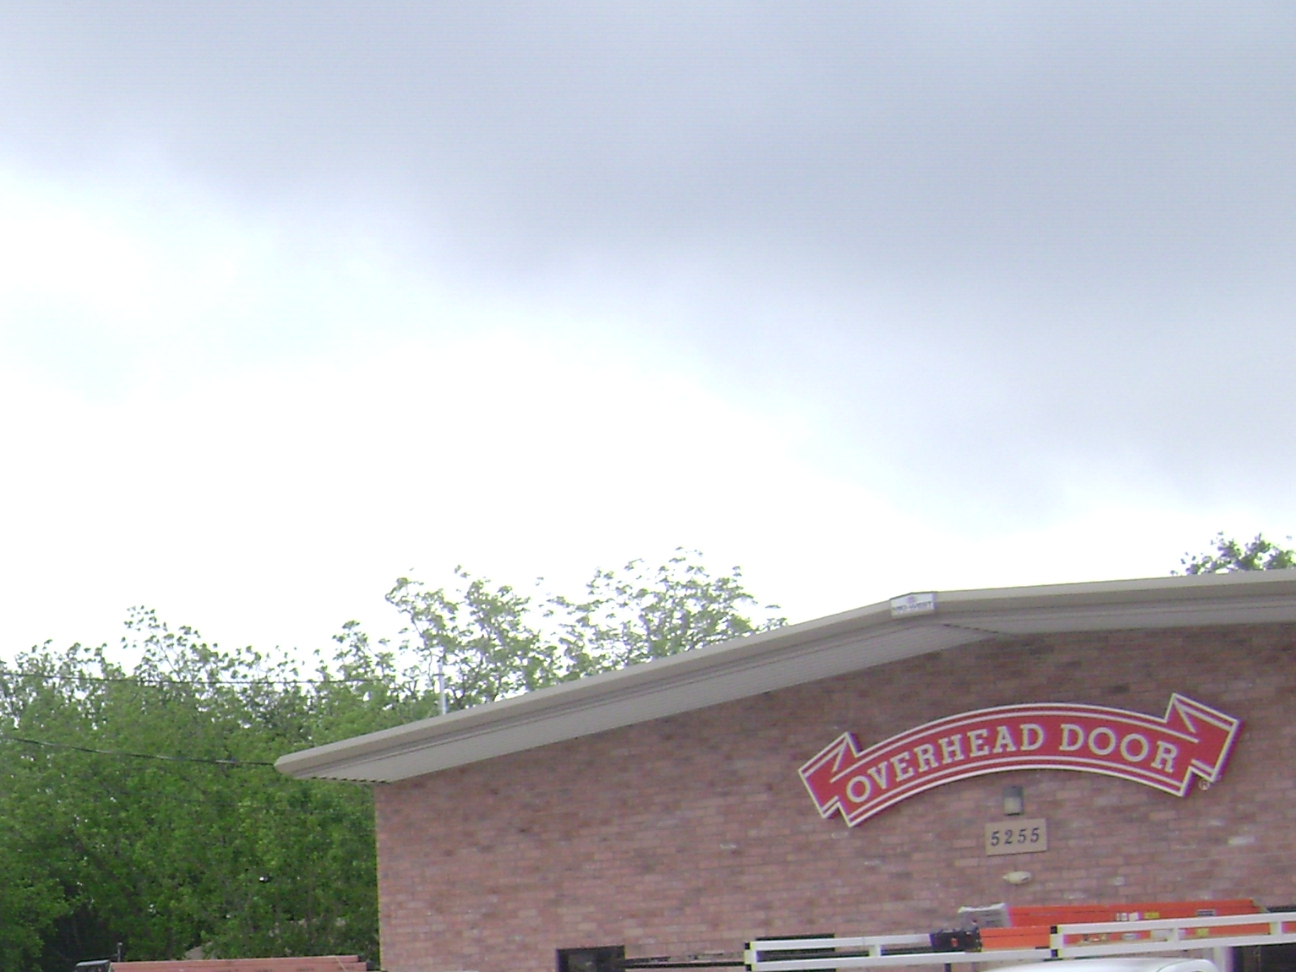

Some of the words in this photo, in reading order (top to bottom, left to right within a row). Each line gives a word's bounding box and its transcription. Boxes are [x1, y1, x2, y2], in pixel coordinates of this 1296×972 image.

[845, 724, 1045, 803] OVERHEAD
[1059, 724, 1179, 774] DOOR
[989, 826, 1042, 848] 5255
